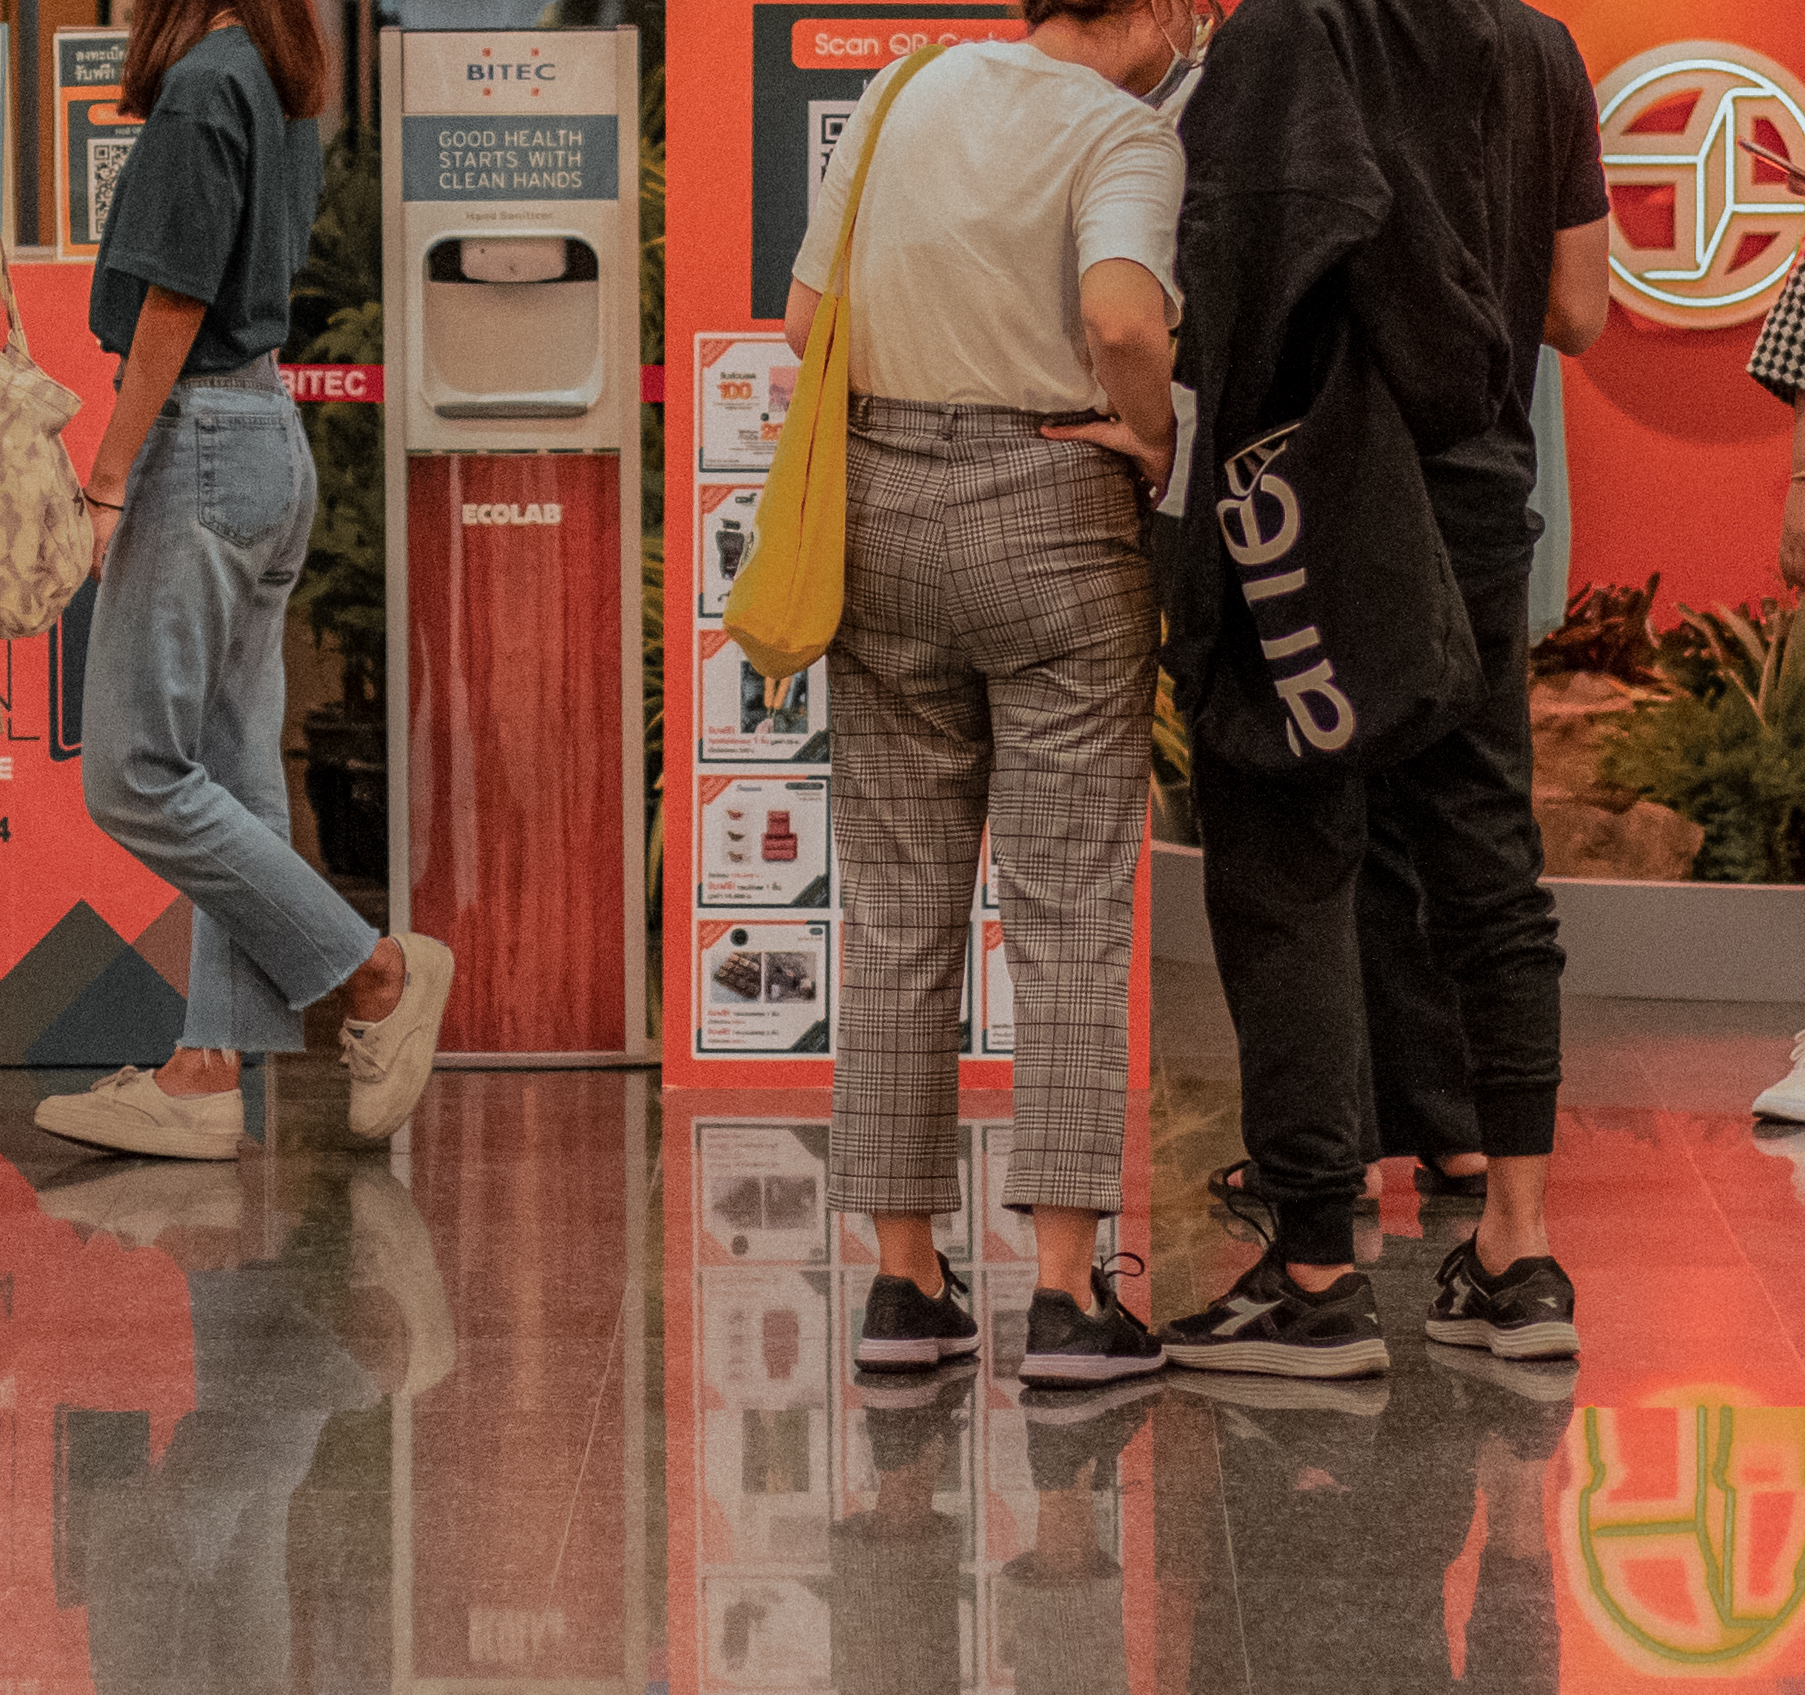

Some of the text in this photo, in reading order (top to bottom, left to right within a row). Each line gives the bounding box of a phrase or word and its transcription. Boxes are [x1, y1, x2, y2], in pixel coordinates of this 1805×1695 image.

[815, 33, 879, 56] Scan
[467, 63, 556, 81] BITEC
[439, 130, 583, 147] GOOD HEALTH
[439, 151, 582, 168] STARTS WITH
[439, 171, 583, 189] CLEAN HANDS
[462, 503, 563, 525] ECOLAB
